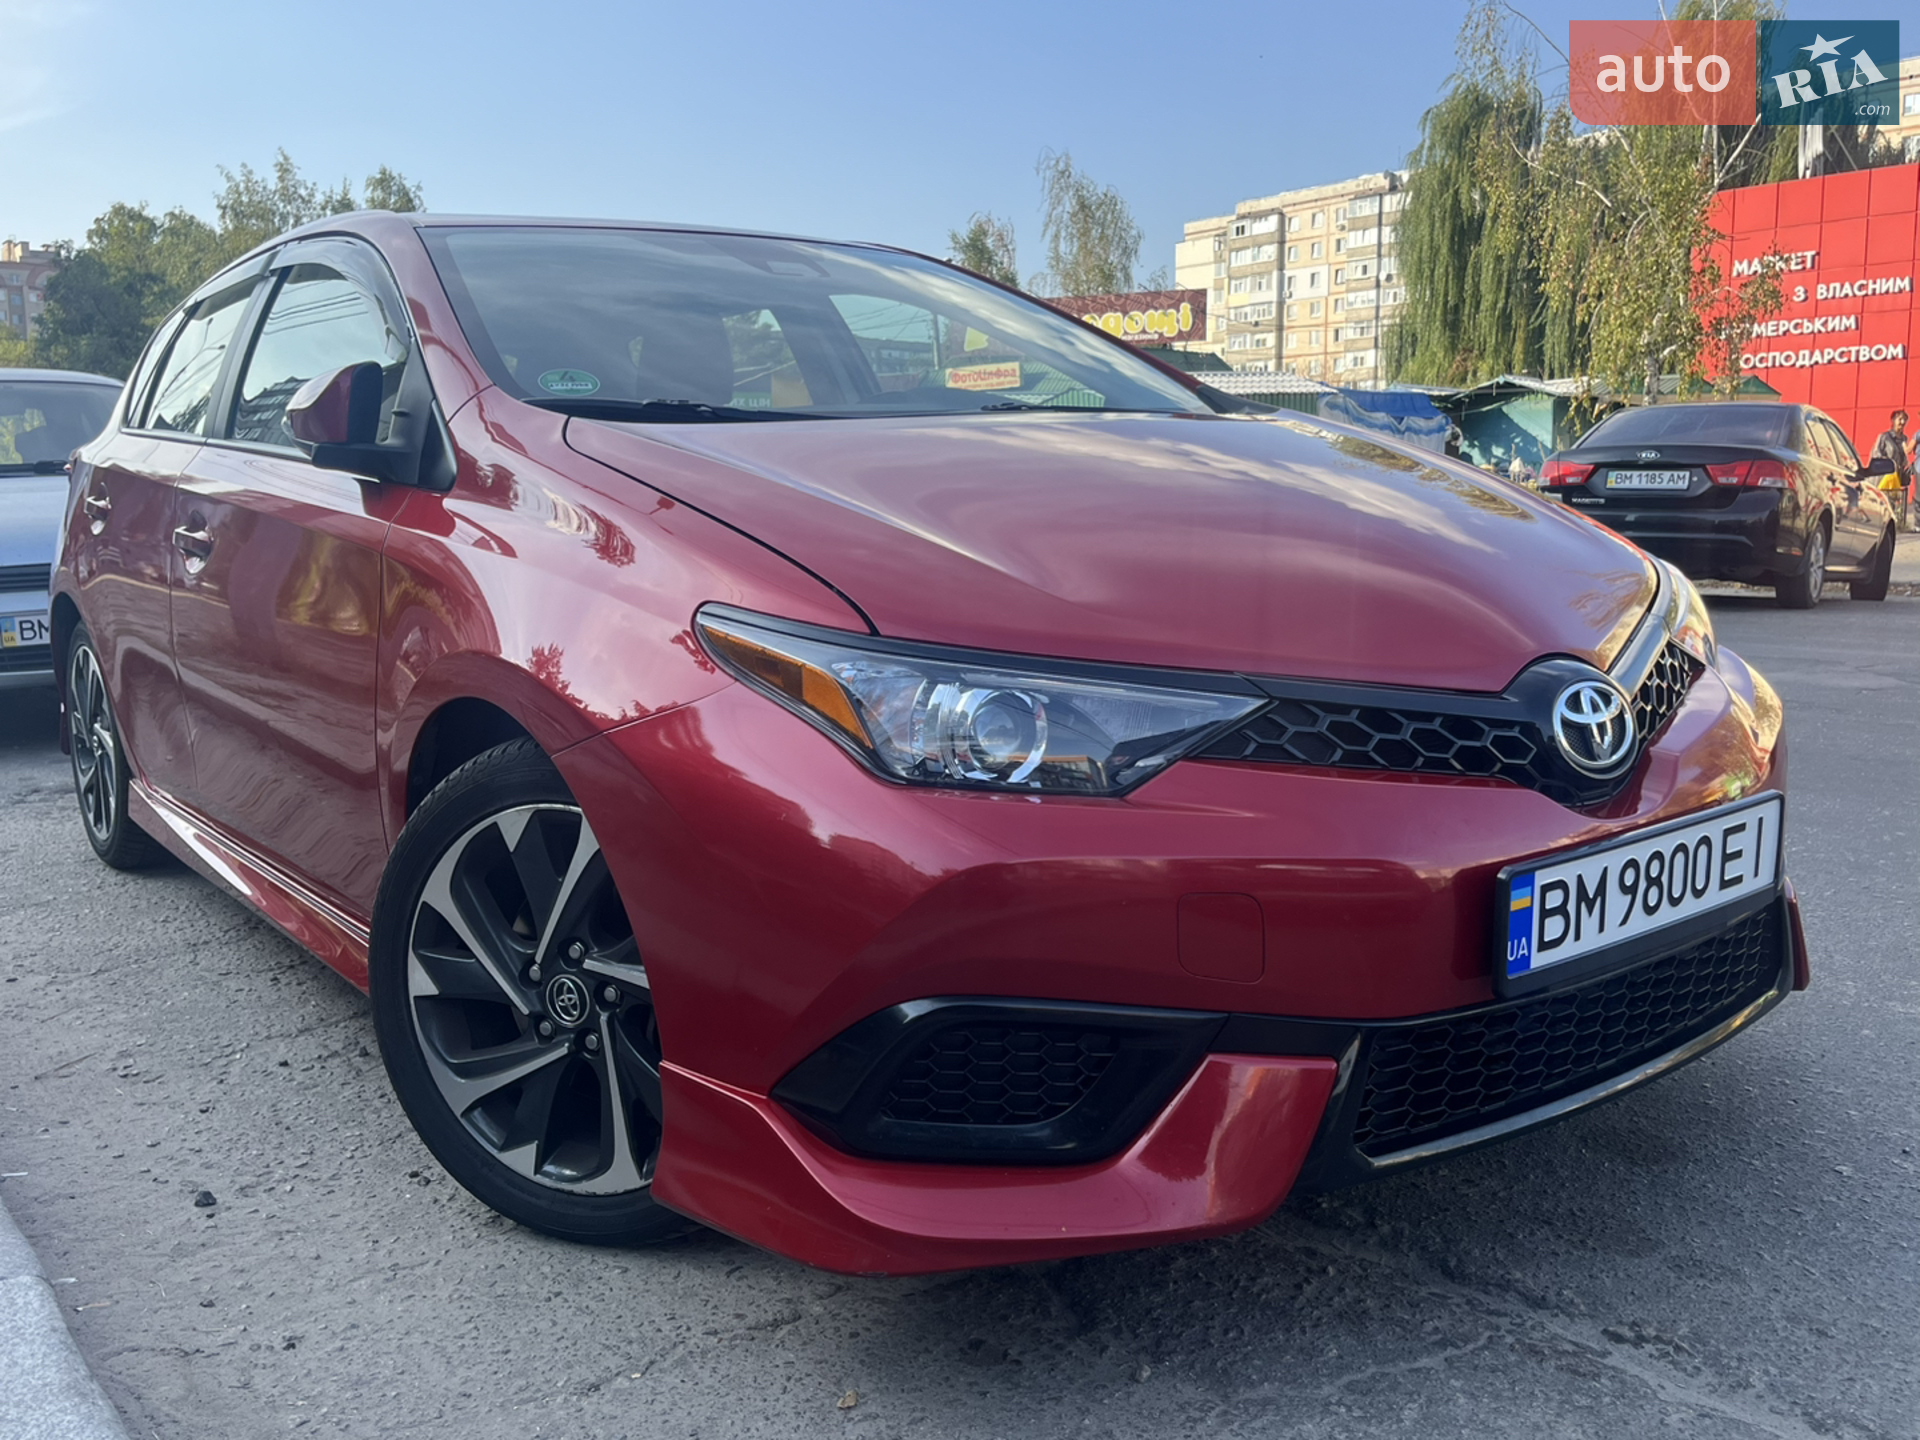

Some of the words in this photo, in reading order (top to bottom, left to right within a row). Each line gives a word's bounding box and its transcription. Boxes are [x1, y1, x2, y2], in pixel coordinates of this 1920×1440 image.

[1816, 276, 1911, 300] ВЛАСНИМ
[1721, 314, 1857, 340] МЕРСЬКИМ
[1732, 343, 1904, 370] ОСПОДАРСТВОМ
[1636, 472, 1664, 485] 1185
[1667, 472, 1686, 485] AM
[1507, 937, 1528, 961] UA
